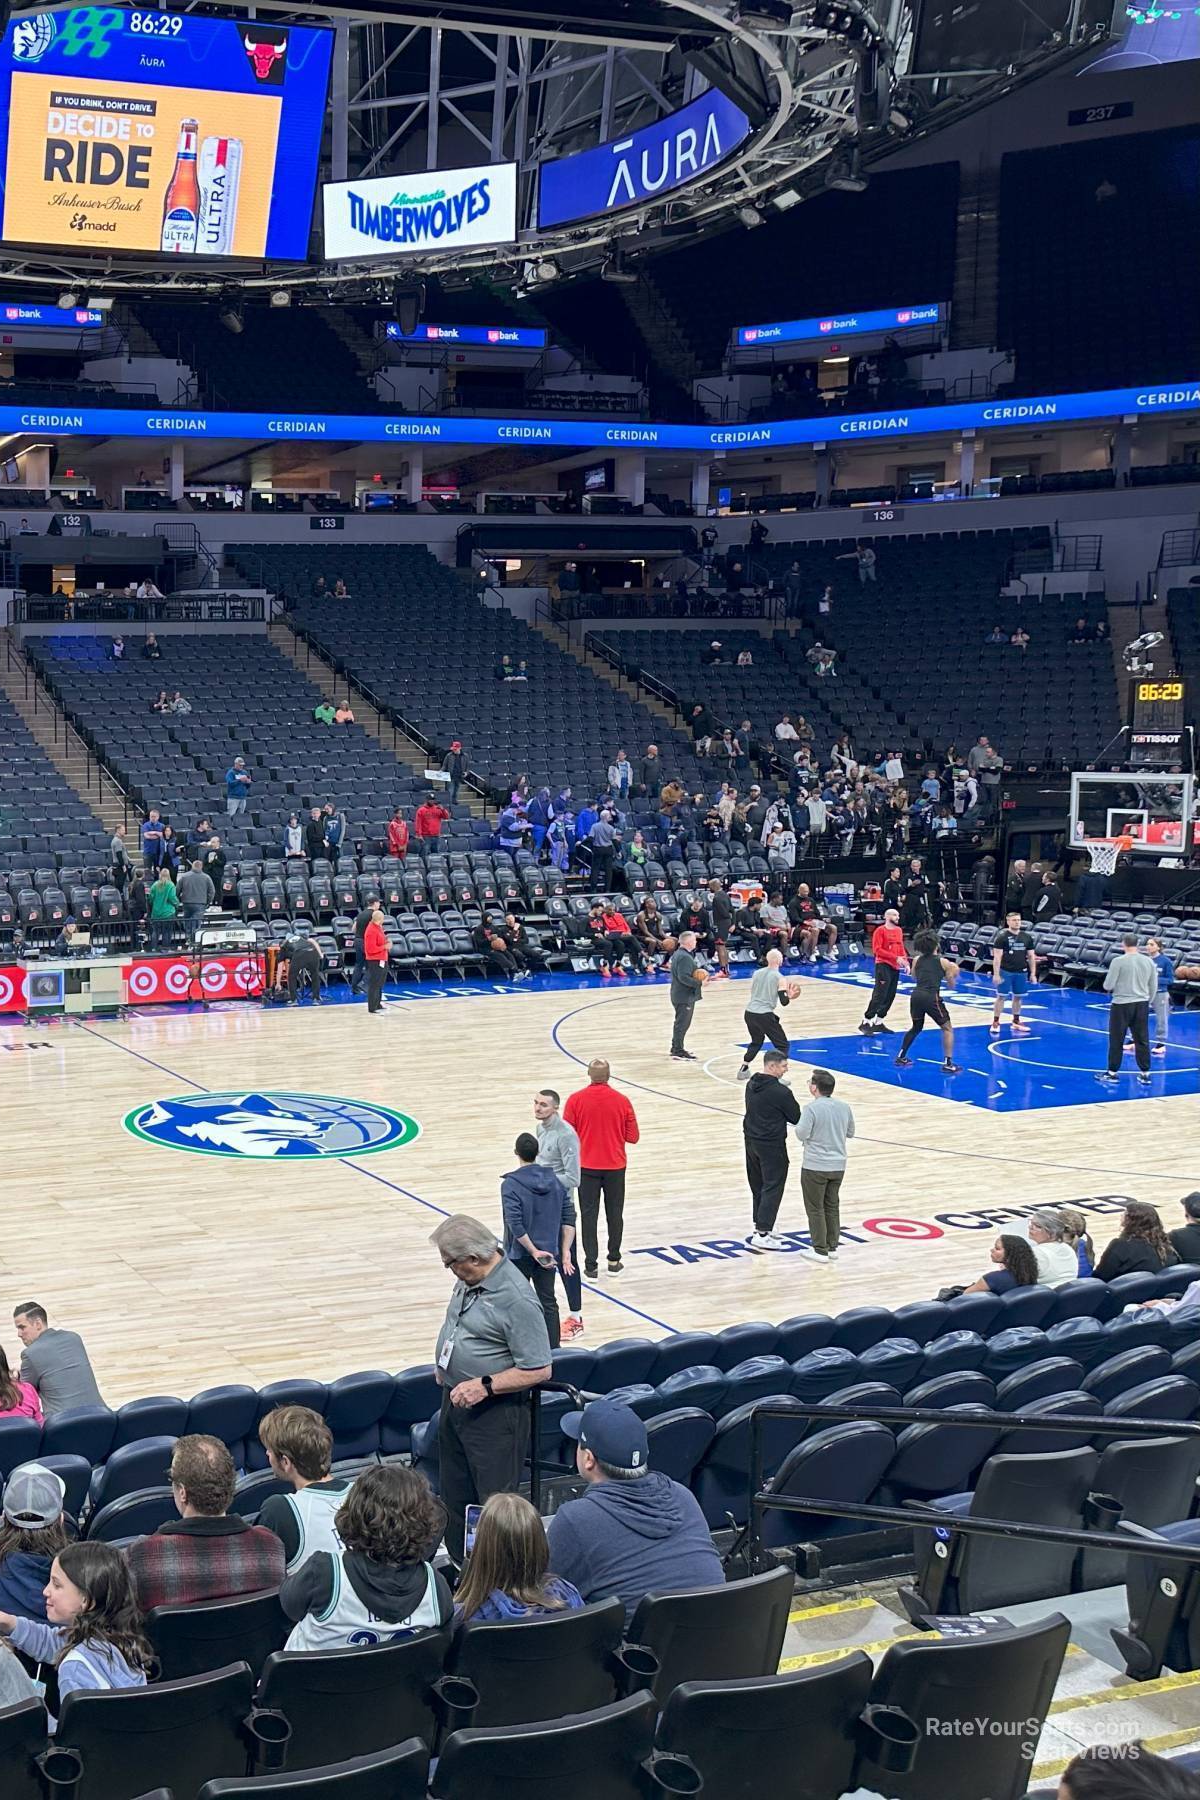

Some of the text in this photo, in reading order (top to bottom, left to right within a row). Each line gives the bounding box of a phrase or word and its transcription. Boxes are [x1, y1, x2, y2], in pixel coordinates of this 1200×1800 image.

[130, 13, 184, 37] 86:29
[63, 97, 79, 106] YOU
[80, 99, 105, 109] DRINK,
[105, 101, 129, 110] DON'T
[129, 103, 153, 113] DRIVE.
[1086, 106, 1112, 121] 237
[48, 111, 155, 141] DECIDE TO
[43, 138, 153, 189] RIDE
[206, 175, 226, 243] ULTRA
[347, 178, 491, 243] TIMBERWOLVES
[84, 222, 116, 232] madd
[164, 231, 195, 241] ULTRA
[983, 403, 1056, 420] CERIDIAN
[21, 415, 83, 427] CERIDIAN
[147, 418, 206, 430] CERIDIAN
[268, 421, 326, 433] CERIDIAN
[841, 416, 909, 432] CERIDIAN
[385, 424, 441, 435] CERIDIAN
[497, 427, 551, 438] CERIDIAN
[606, 430, 658, 441] CERIDIAN
[710, 430, 771, 443] CERIDIAN
[62, 516, 81, 526] 132
[873, 511, 894, 520] 136
[319, 518, 336, 528] 133
[1138, 683, 1183, 701] 86:29
[553, 901, 561, 910] G
[576, 900, 585, 909] G
